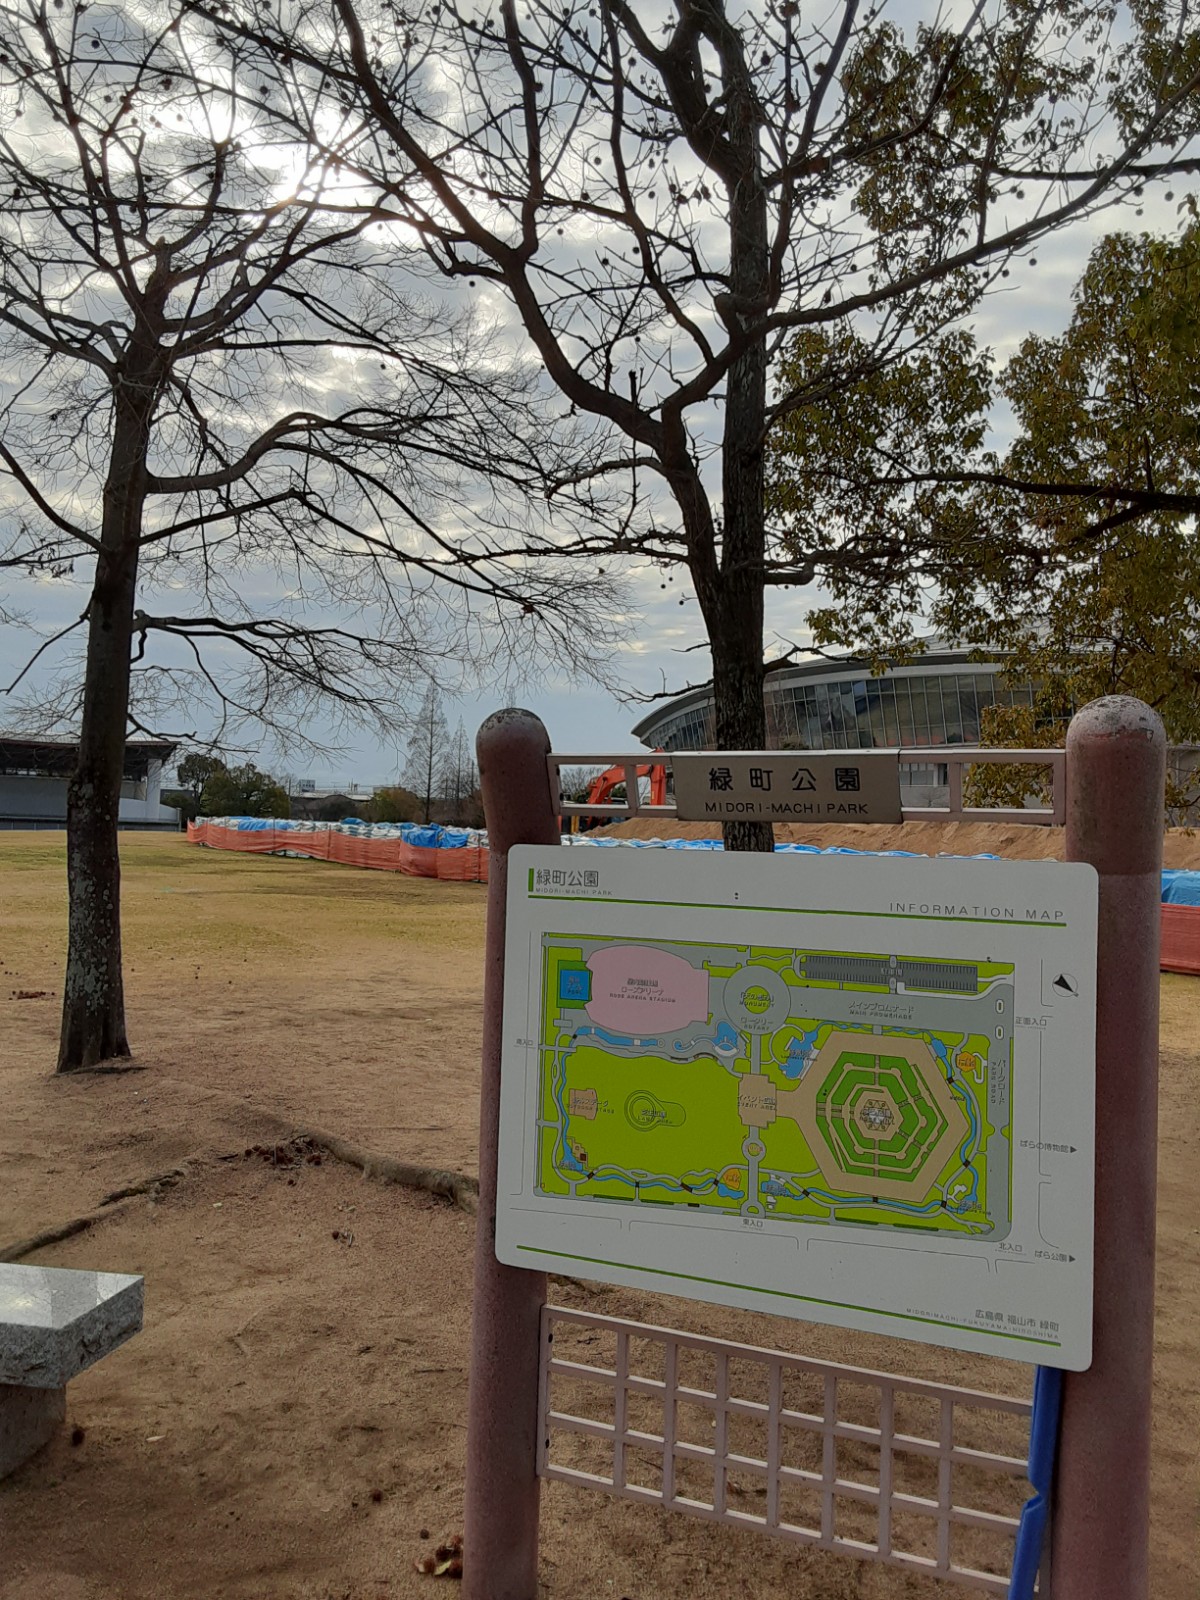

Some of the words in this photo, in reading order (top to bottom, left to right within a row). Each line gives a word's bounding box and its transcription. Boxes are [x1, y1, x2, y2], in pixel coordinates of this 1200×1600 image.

[709, 767, 861, 792] 緑町公園
[705, 802, 820, 814] MIDORI-MACHI
[827, 802, 869, 815] PARK
[536, 869, 599, 887] 緑町公園
[889, 902, 1015, 918] INFORMATION
[1025, 909, 1064, 921] MAP
[998, 1242, 1023, 1252] 北入口
[975, 1309, 1004, 1322] 広島県
[1007, 1314, 1036, 1328] 福山市
